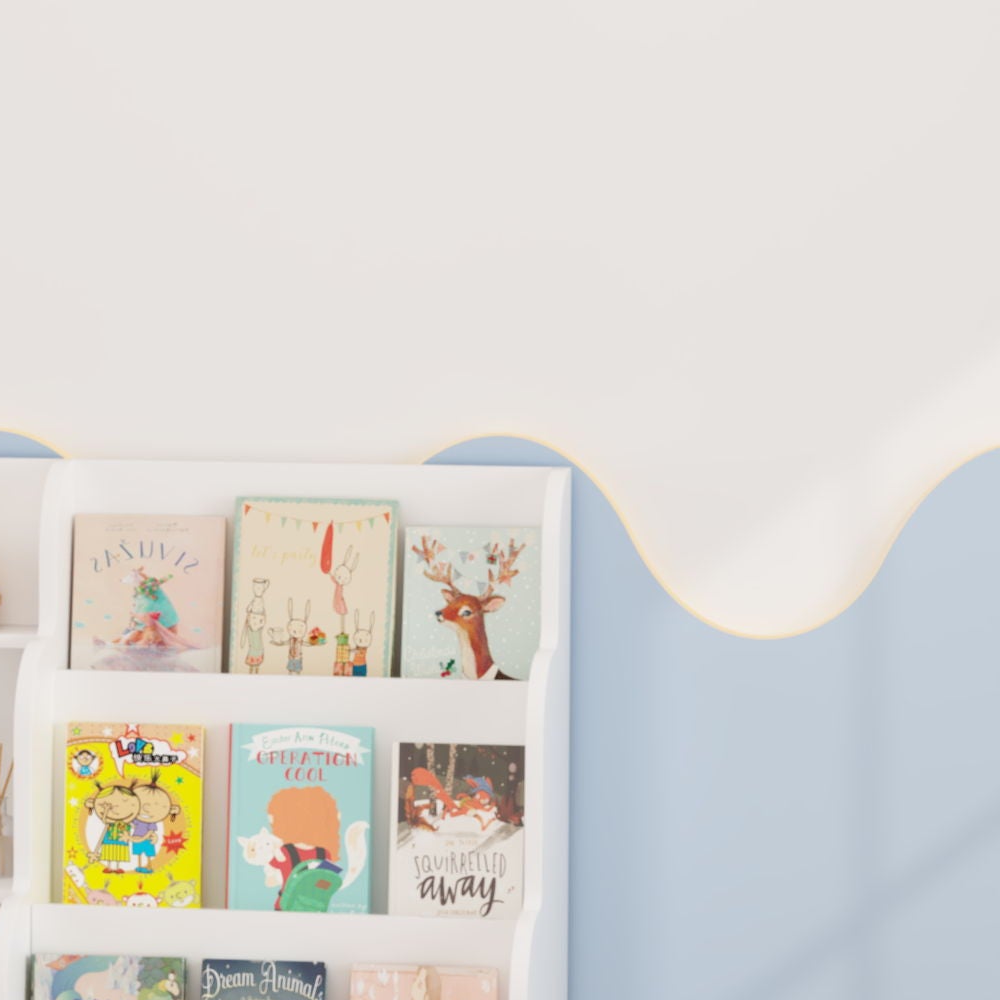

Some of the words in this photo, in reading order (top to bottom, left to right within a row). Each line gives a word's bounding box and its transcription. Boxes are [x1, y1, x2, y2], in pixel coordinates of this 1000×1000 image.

[256, 751, 357, 767] OPERATION
[284, 767, 328, 782] COOL
[414, 851, 507, 879] SQUIRRELLED
[417, 875, 504, 917] away
